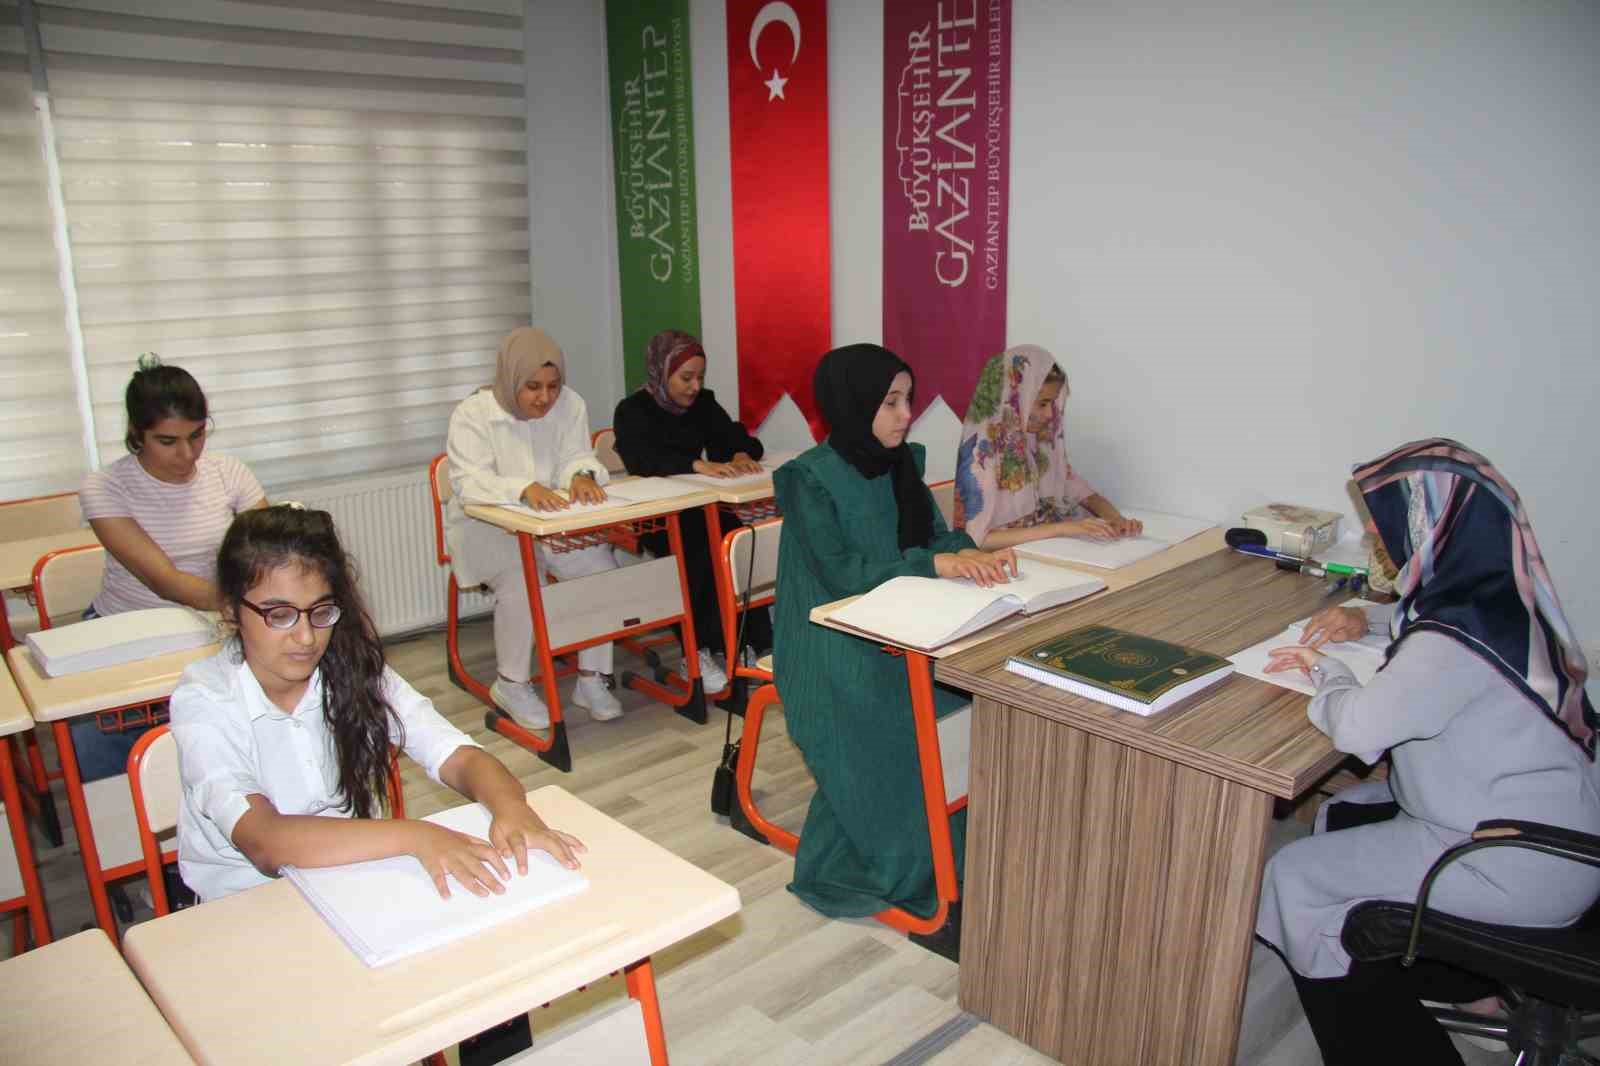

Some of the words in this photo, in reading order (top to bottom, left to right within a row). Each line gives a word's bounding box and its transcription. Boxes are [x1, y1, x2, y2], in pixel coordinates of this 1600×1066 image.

[642, 24, 675, 283] GAZİANTEP
[908, 22, 935, 231] BÜYÜKŞEHİR
[985, 64, 1004, 183] BÜYÜKŞEHİR
[985, 185, 1001, 289] GAZİANTEP
